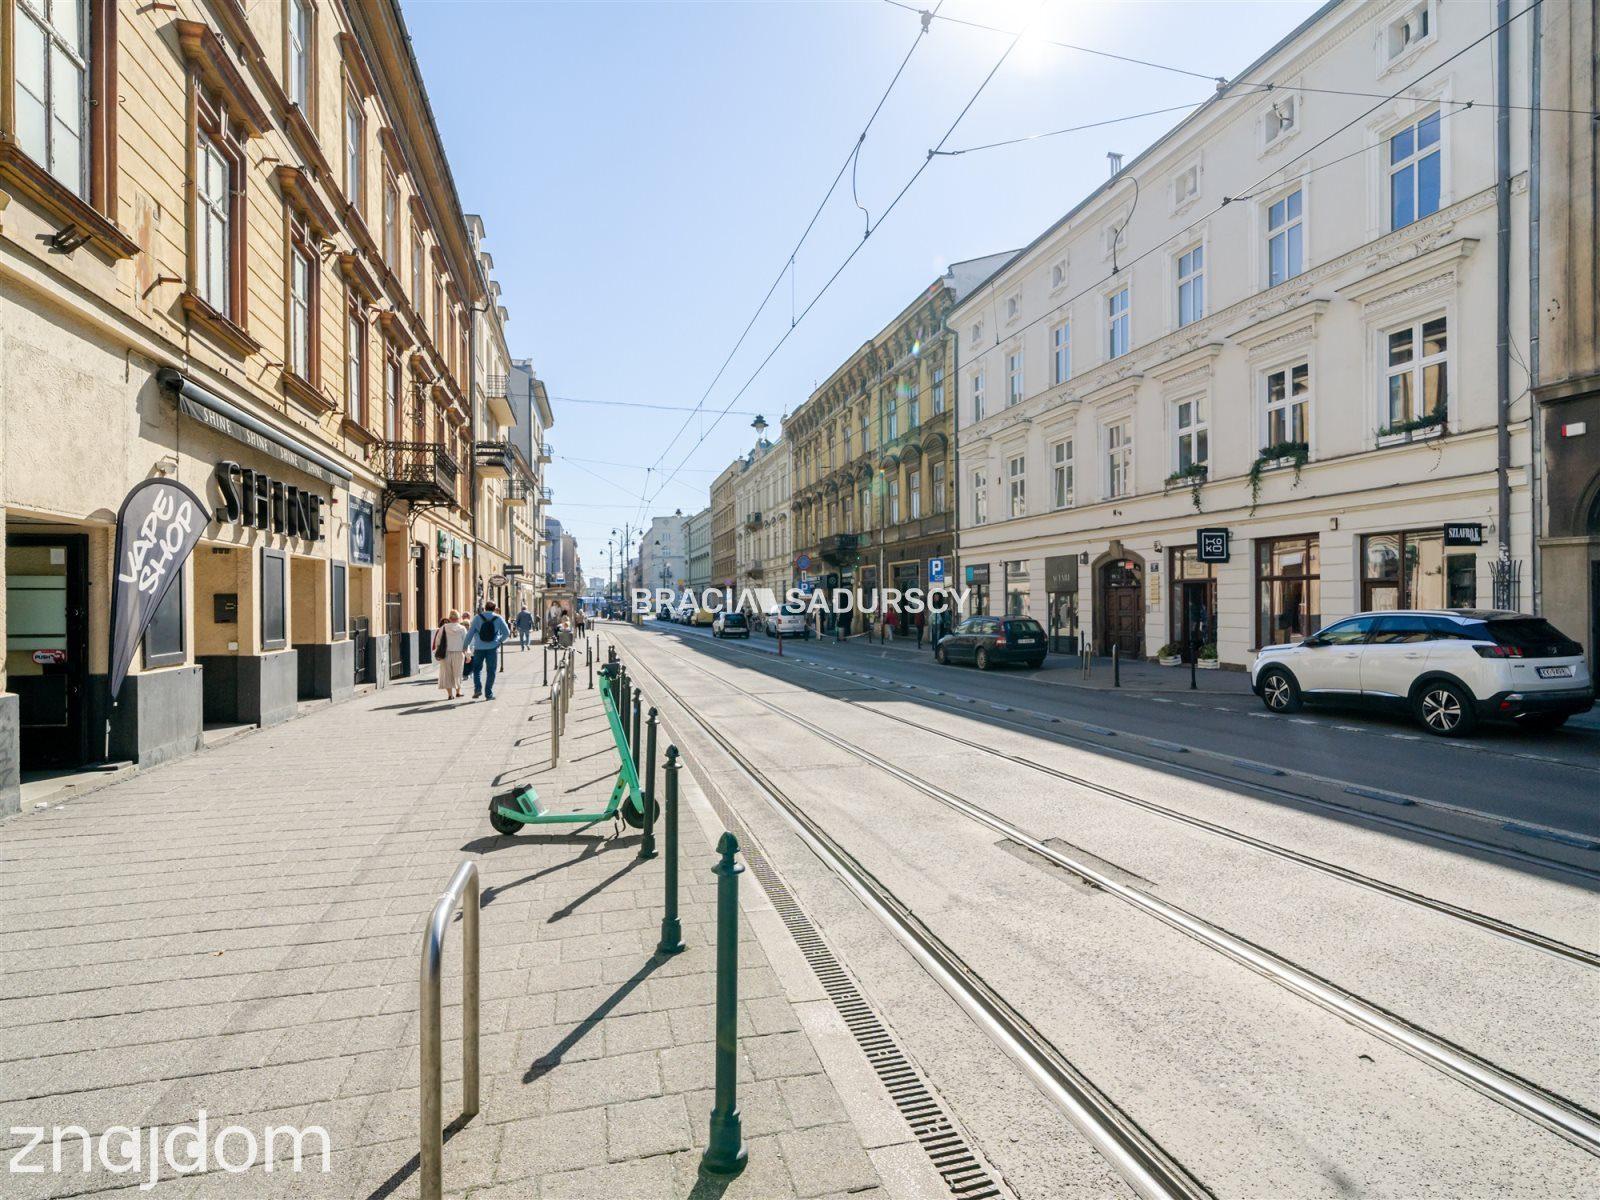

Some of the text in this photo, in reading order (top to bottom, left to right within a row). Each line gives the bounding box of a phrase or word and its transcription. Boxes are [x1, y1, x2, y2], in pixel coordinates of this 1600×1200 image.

[203, 409, 232, 433] SHINE
[246, 430, 268, 452] SHINE
[280, 449, 298, 466] SHINE
[215, 460, 325, 542] SHINE
[119, 488, 174, 582] VAPE
[139, 501, 191, 594] SHOP
[932, 560, 941, 576] P
